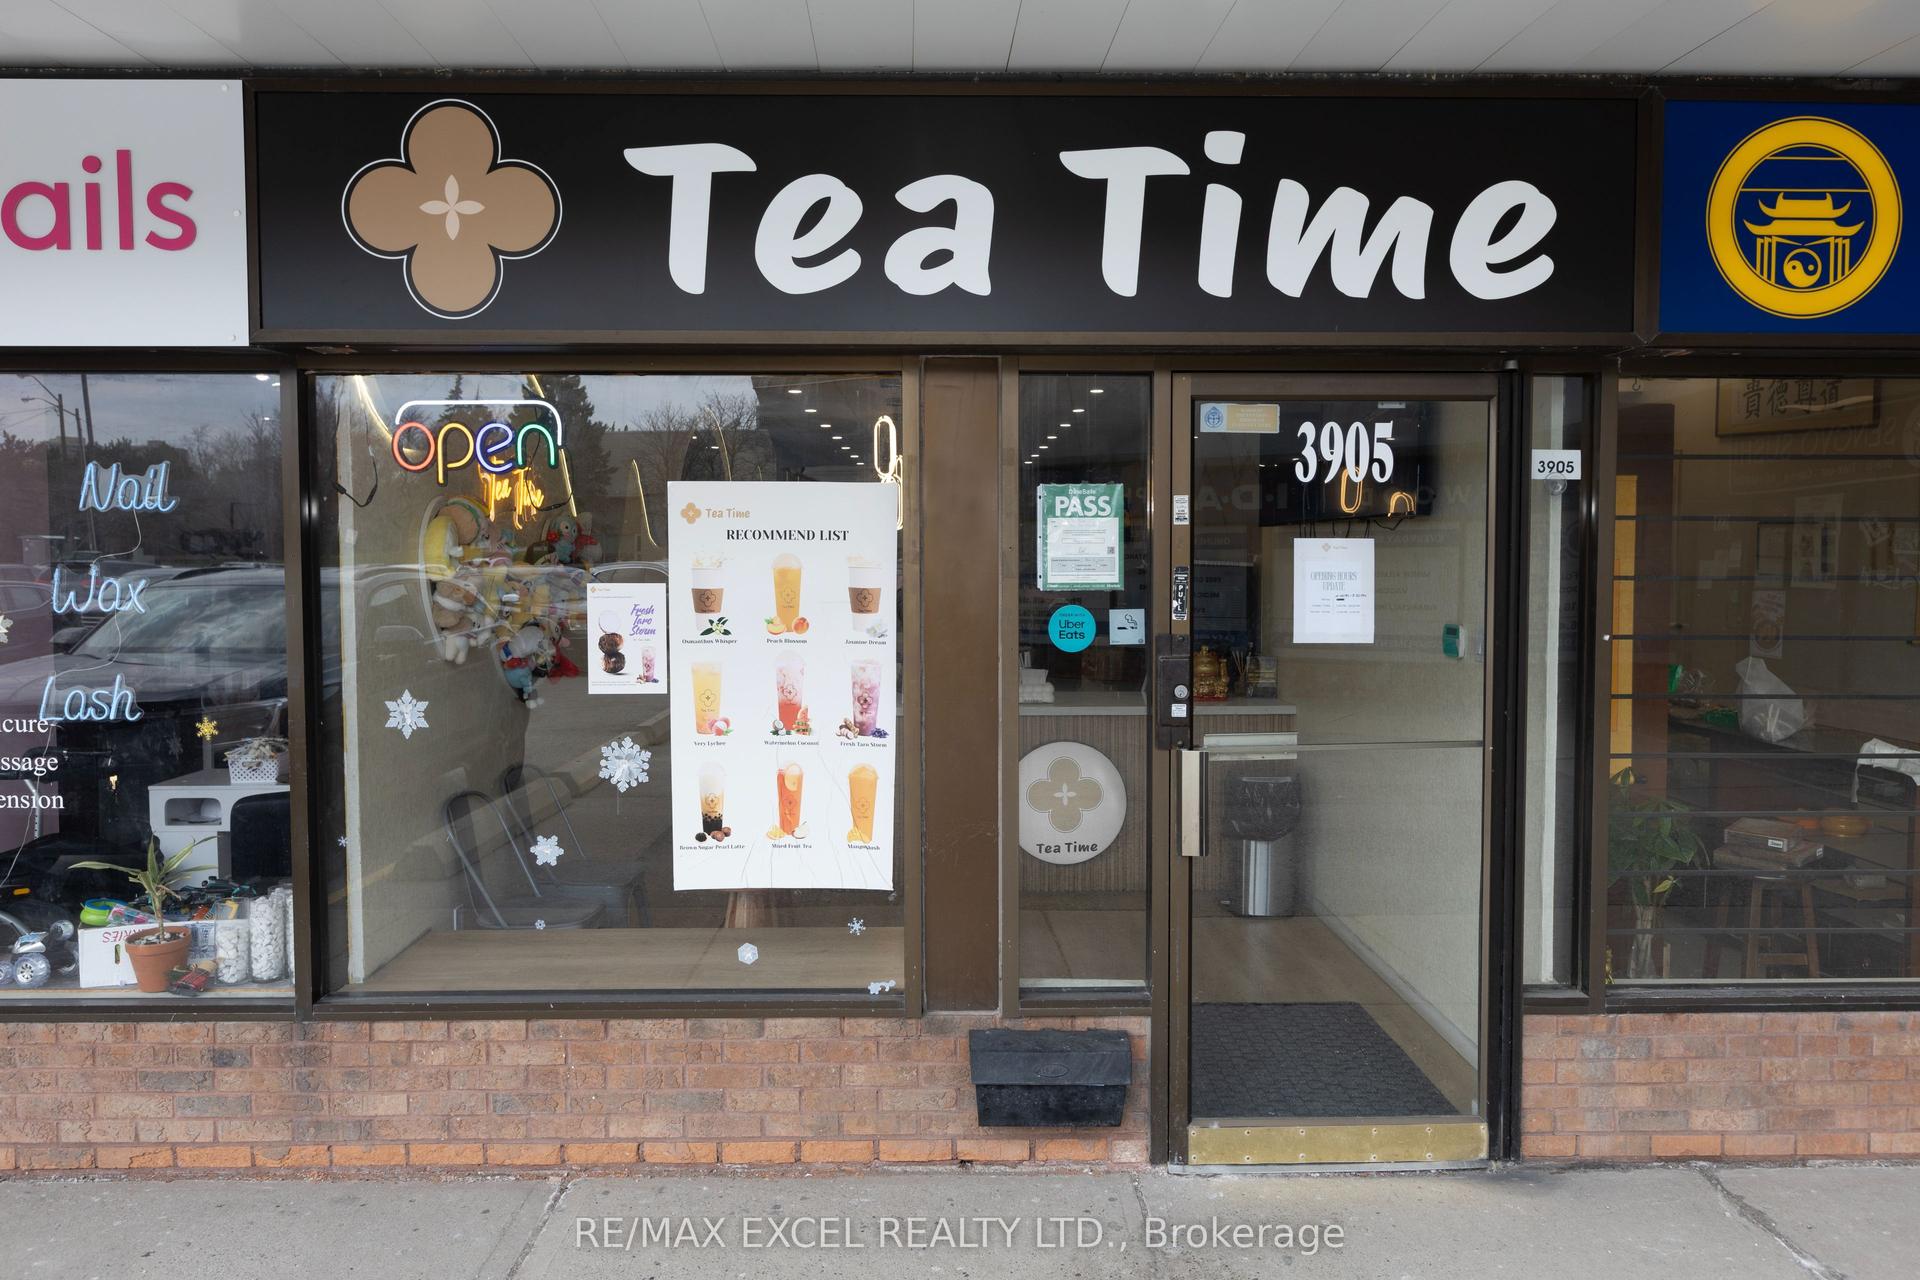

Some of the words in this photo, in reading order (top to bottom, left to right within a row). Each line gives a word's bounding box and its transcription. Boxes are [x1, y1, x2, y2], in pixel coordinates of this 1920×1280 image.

[1, 149, 197, 251] ails
[623, 143, 996, 297] Tea
[1059, 130, 1558, 301] Time
[392, 421, 559, 486] open
[1295, 420, 1394, 484] 3905
[1537, 460, 1575, 474] 3905
[79, 461, 176, 512] Nail
[706, 508, 724, 519] Tea
[726, 507, 751, 519] Time
[1055, 495, 1112, 517] PASS
[726, 529, 816, 541] RECOMMEND
[819, 530, 850, 541] LIST
[1310, 571, 1336, 581] OPENING
[1337, 571, 1358, 581] HOURS
[51, 564, 149, 614] Wax
[1321, 581, 1346, 591] UPDATE
[1178, 585, 1186, 611] PULL
[630, 604, 655, 616] Fresh
[629, 625, 656, 636] Storm
[1058, 619, 1085, 629] Uber
[1058, 630, 1086, 640] Eats
[40, 673, 143, 722] Lash
[1036, 842, 1061, 854] Tea
[1064, 841, 1098, 854] Time
